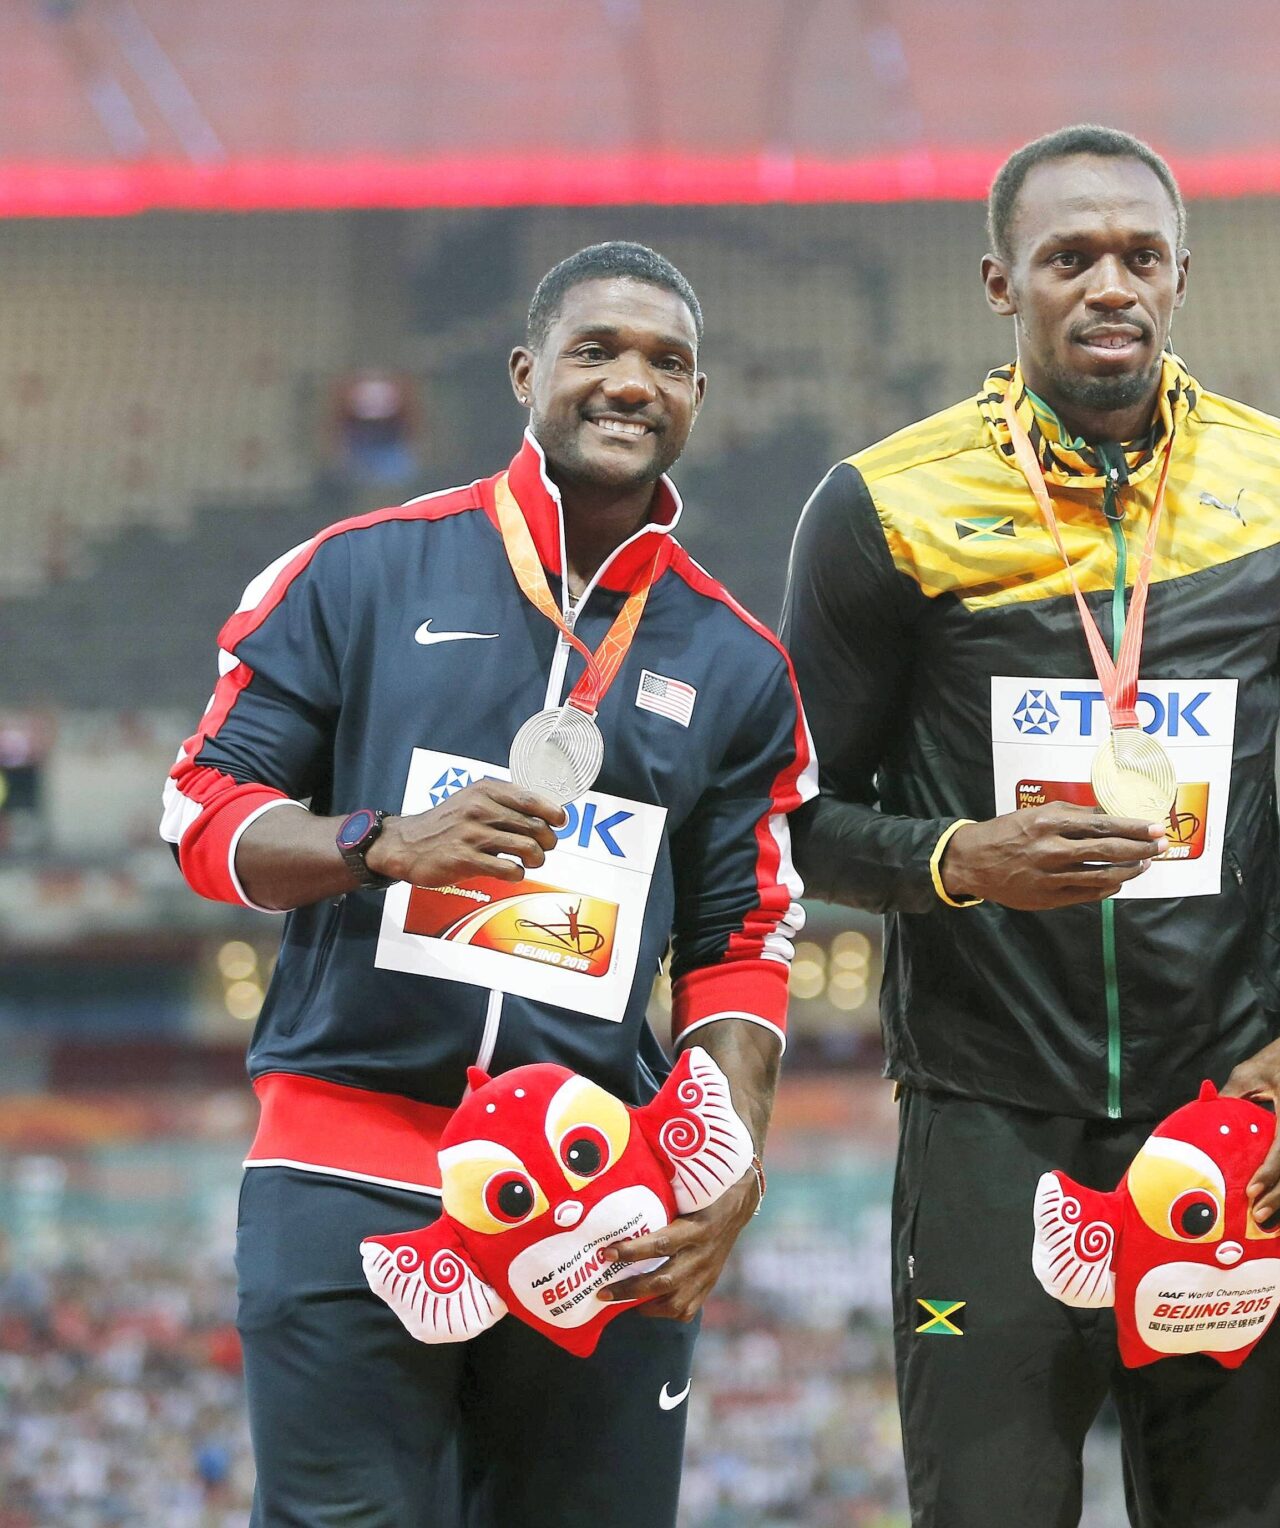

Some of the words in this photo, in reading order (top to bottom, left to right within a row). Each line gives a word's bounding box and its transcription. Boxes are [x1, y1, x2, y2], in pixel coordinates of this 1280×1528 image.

[1060, 691, 1212, 736] TDK
[1019, 784, 1042, 793] IAAF
[1019, 792, 1046, 803] World
[1166, 845, 1191, 858] 2015
[416, 884, 491, 902] pionships
[512, 943, 562, 964] BEIJING
[562, 955, 591, 971] 2015
[531, 1271, 556, 1289] IAAF
[557, 1251, 582, 1274] World
[582, 1212, 644, 1254] Championships
[541, 1246, 607, 1306] BEIJING
[550, 1260, 636, 1317] 国际田联世界田
[1158, 1291, 1185, 1300] IAAF
[1187, 1290, 1214, 1300] World
[1216, 1285, 1276, 1298] Championships
[1153, 1302, 1230, 1319] BEIJING
[1231, 1296, 1274, 1316] 2015
[1148, 1314, 1267, 1333] 国际田联世界田径锦标赛
